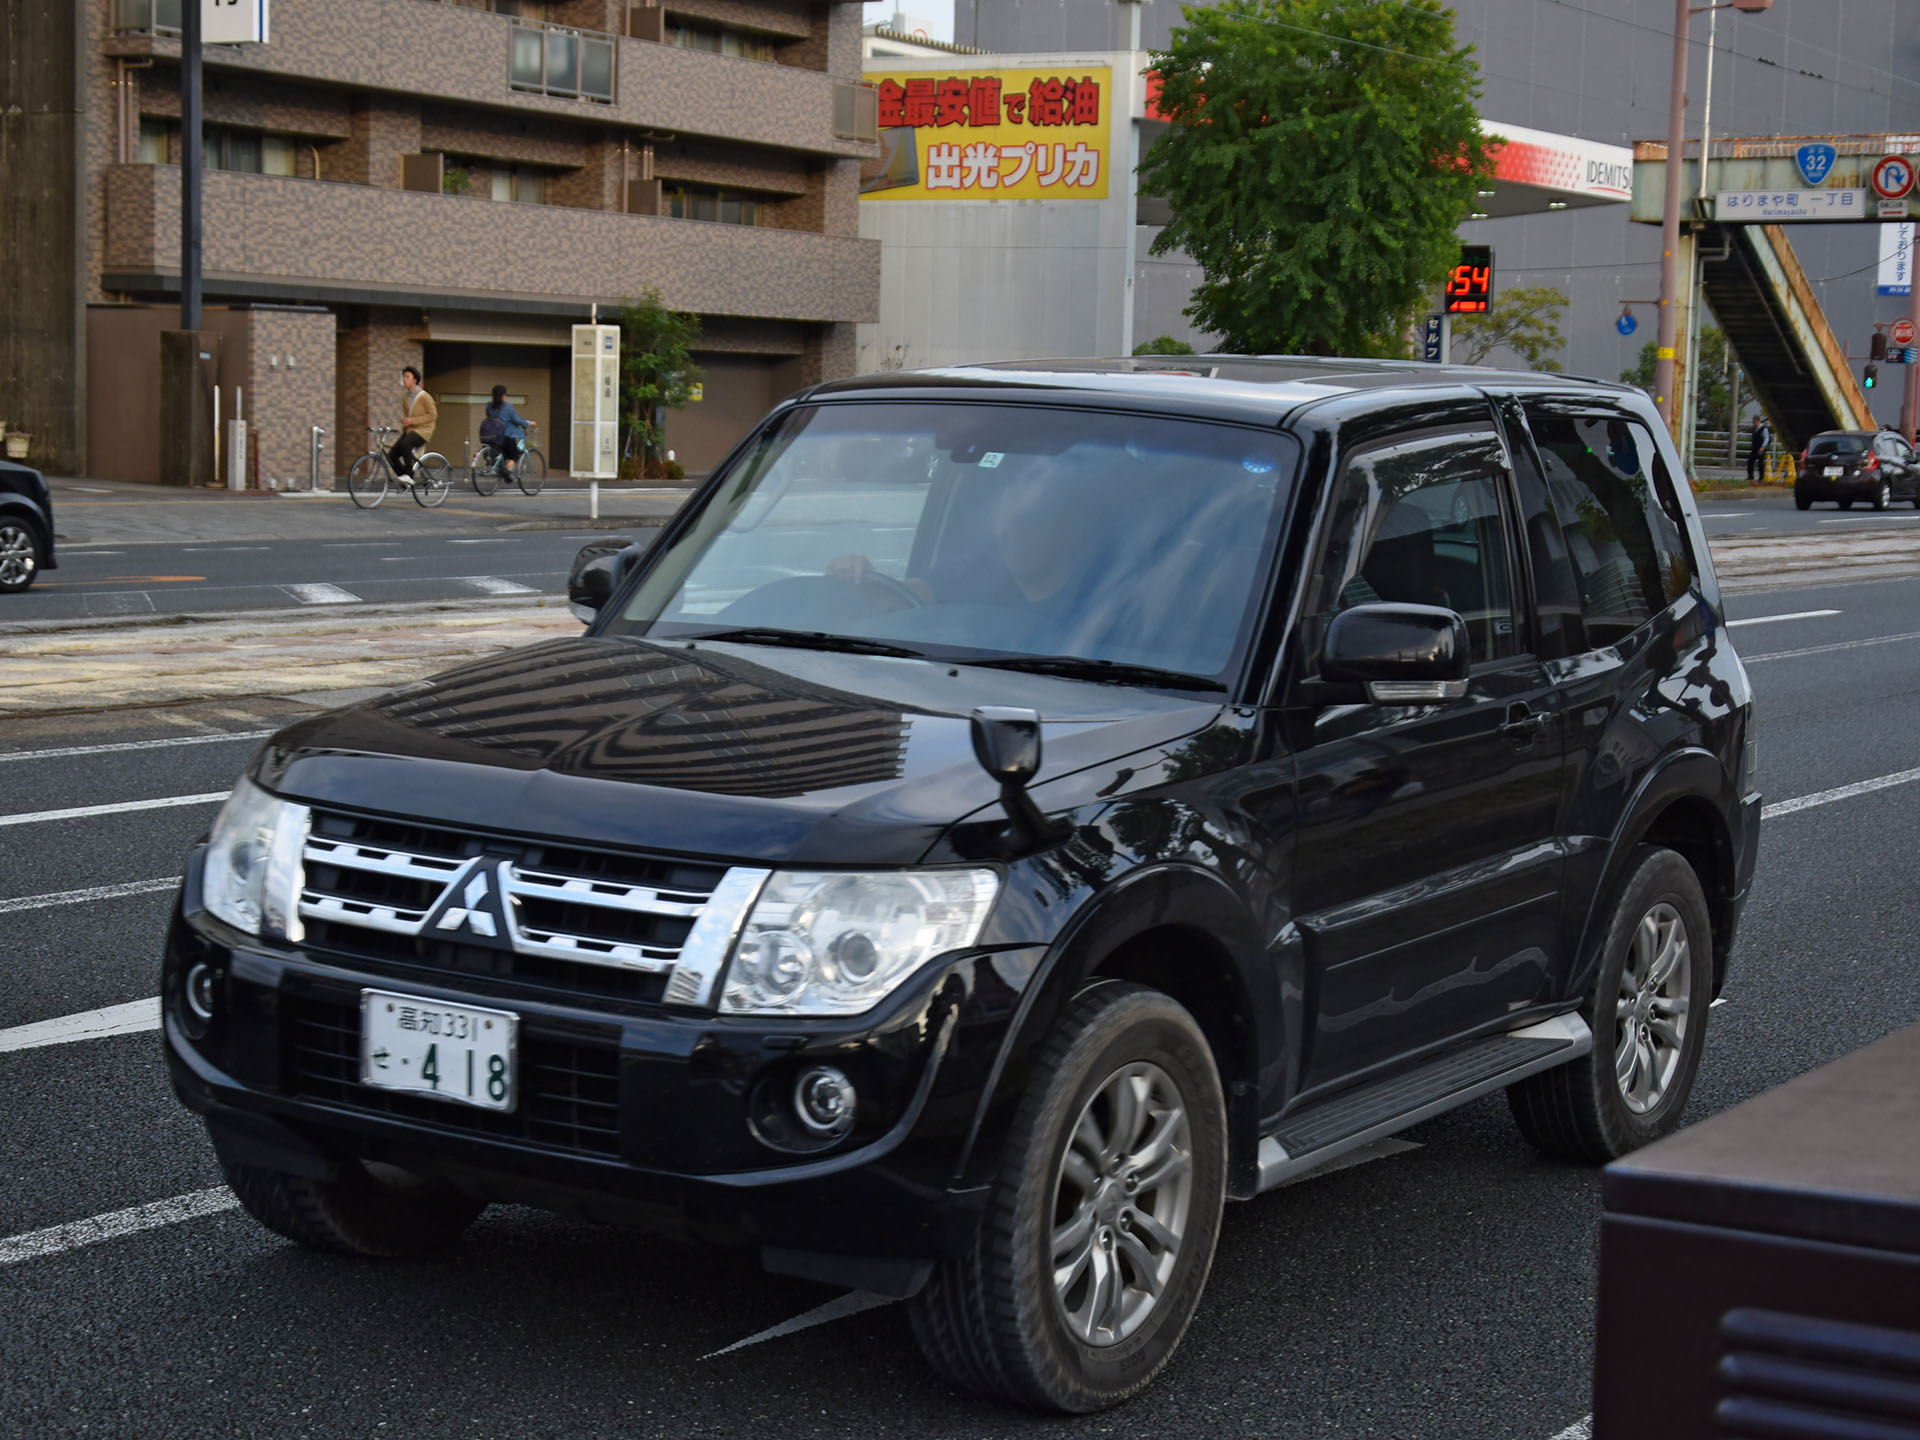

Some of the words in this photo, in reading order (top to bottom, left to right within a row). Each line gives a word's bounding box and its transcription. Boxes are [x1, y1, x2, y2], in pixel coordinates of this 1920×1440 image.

[863, 76, 1100, 128] 金最安値で給油
[926, 141, 1099, 190] 出光プリカ
[1806, 155, 1827, 171] 32
[1727, 193, 1799, 207] はりまや町
[1811, 192, 1853, 206] 一丁目
[1427, 318, 1439, 358] セルフ
[398, 1006, 478, 1041] 高知331
